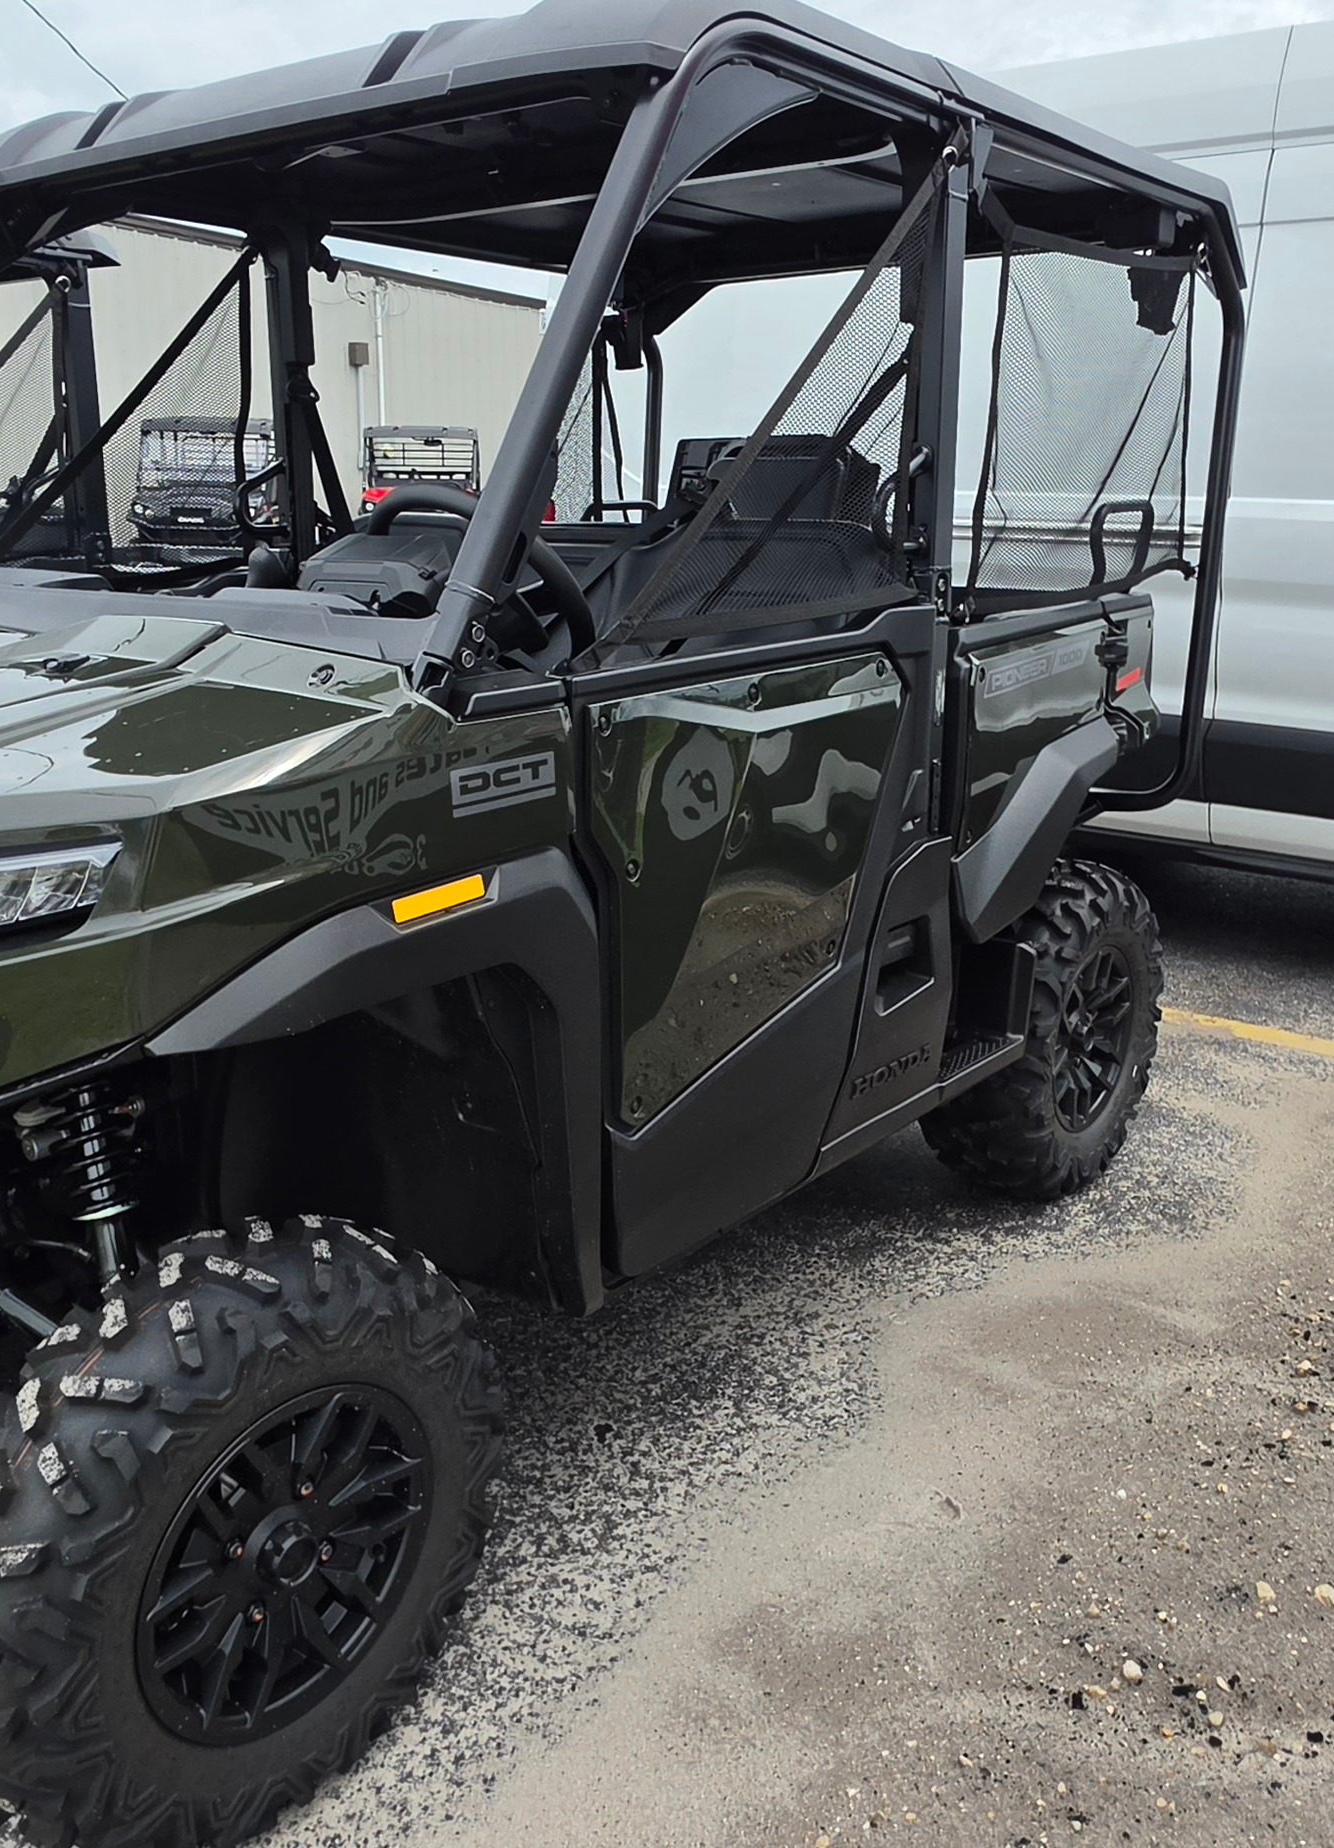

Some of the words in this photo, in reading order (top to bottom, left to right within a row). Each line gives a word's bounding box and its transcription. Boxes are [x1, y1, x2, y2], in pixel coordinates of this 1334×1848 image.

[992, 658, 1048, 691] PIONEER
[459, 758, 549, 797] DCT
[849, 1043, 932, 1101] HONDA
